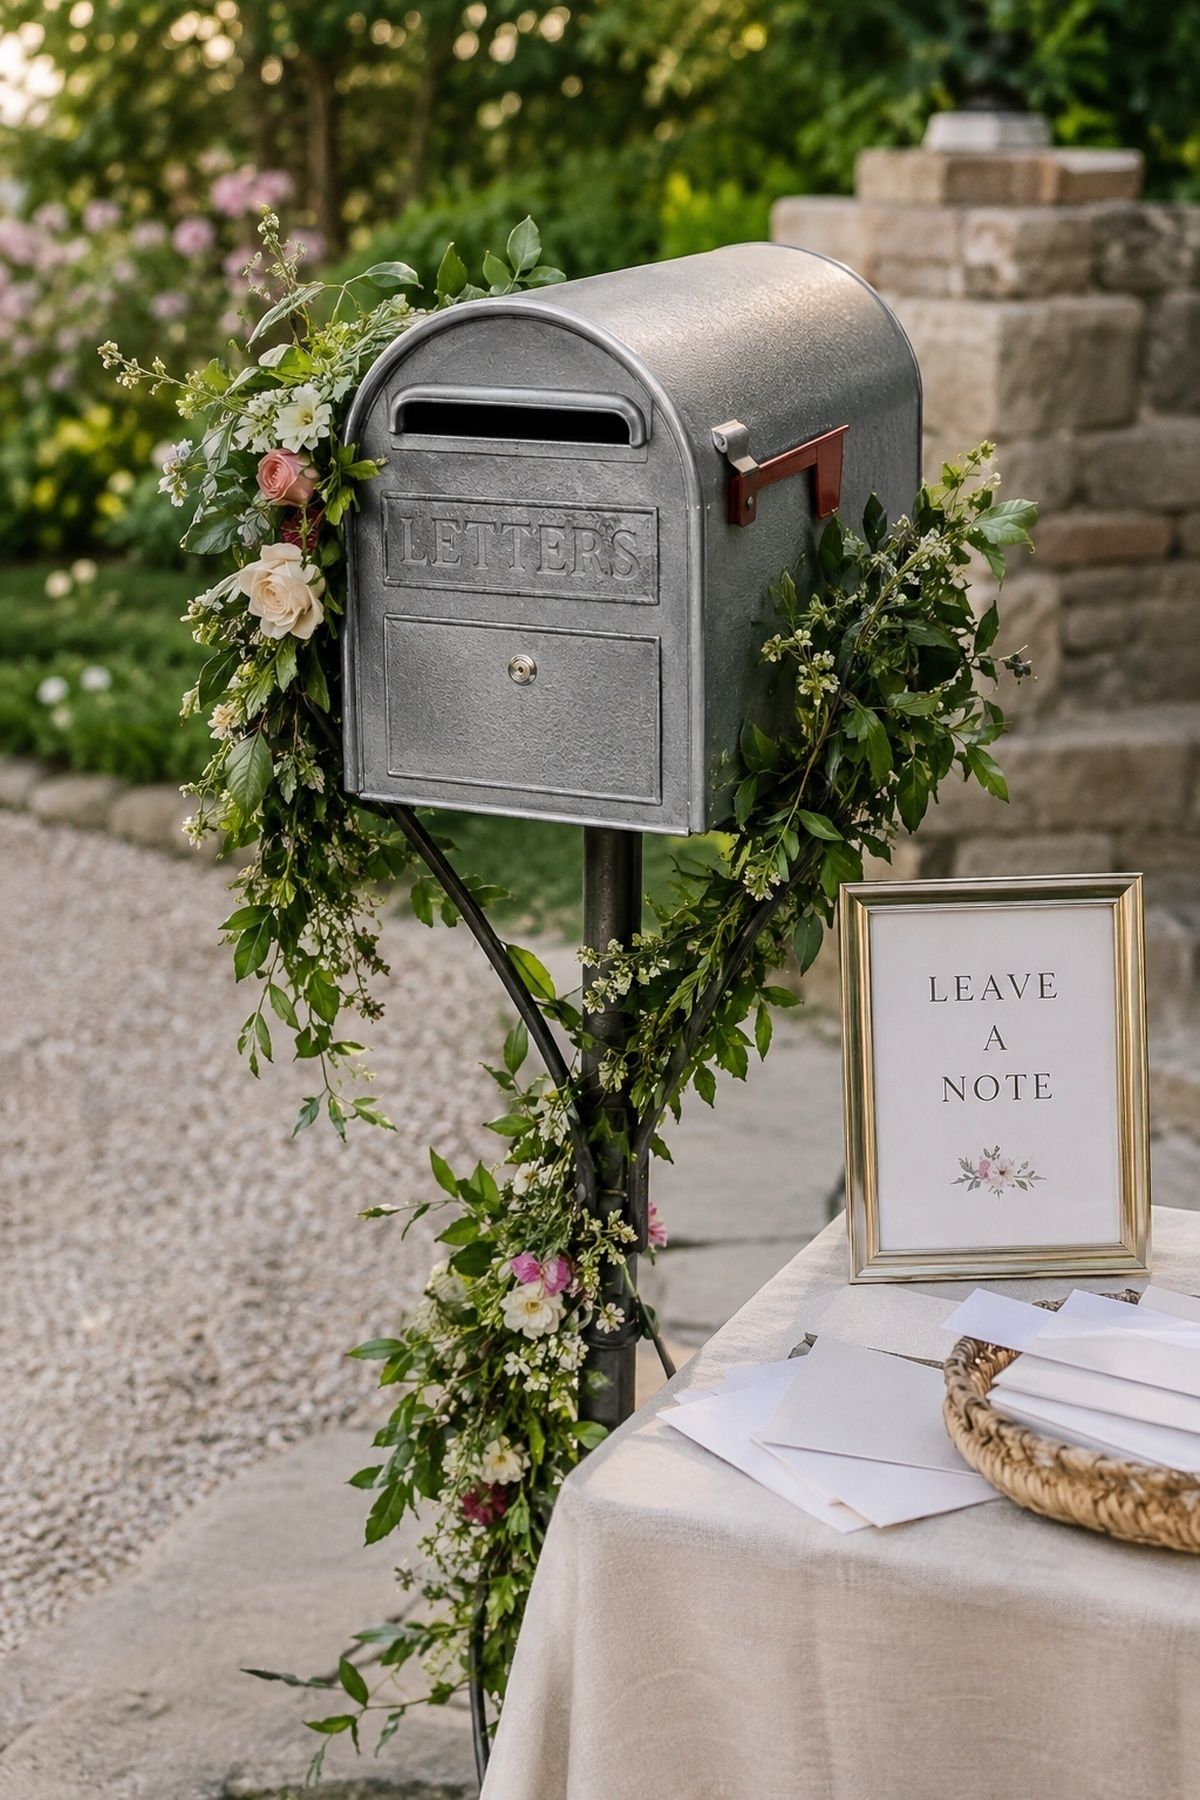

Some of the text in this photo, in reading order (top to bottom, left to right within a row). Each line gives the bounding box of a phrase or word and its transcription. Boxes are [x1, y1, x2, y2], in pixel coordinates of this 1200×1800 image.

[400, 516, 641, 581] LETTERS
[928, 972, 1058, 1003] LEAVE
[982, 1024, 1008, 1052] A
[941, 1072, 1053, 1103] NOTE
